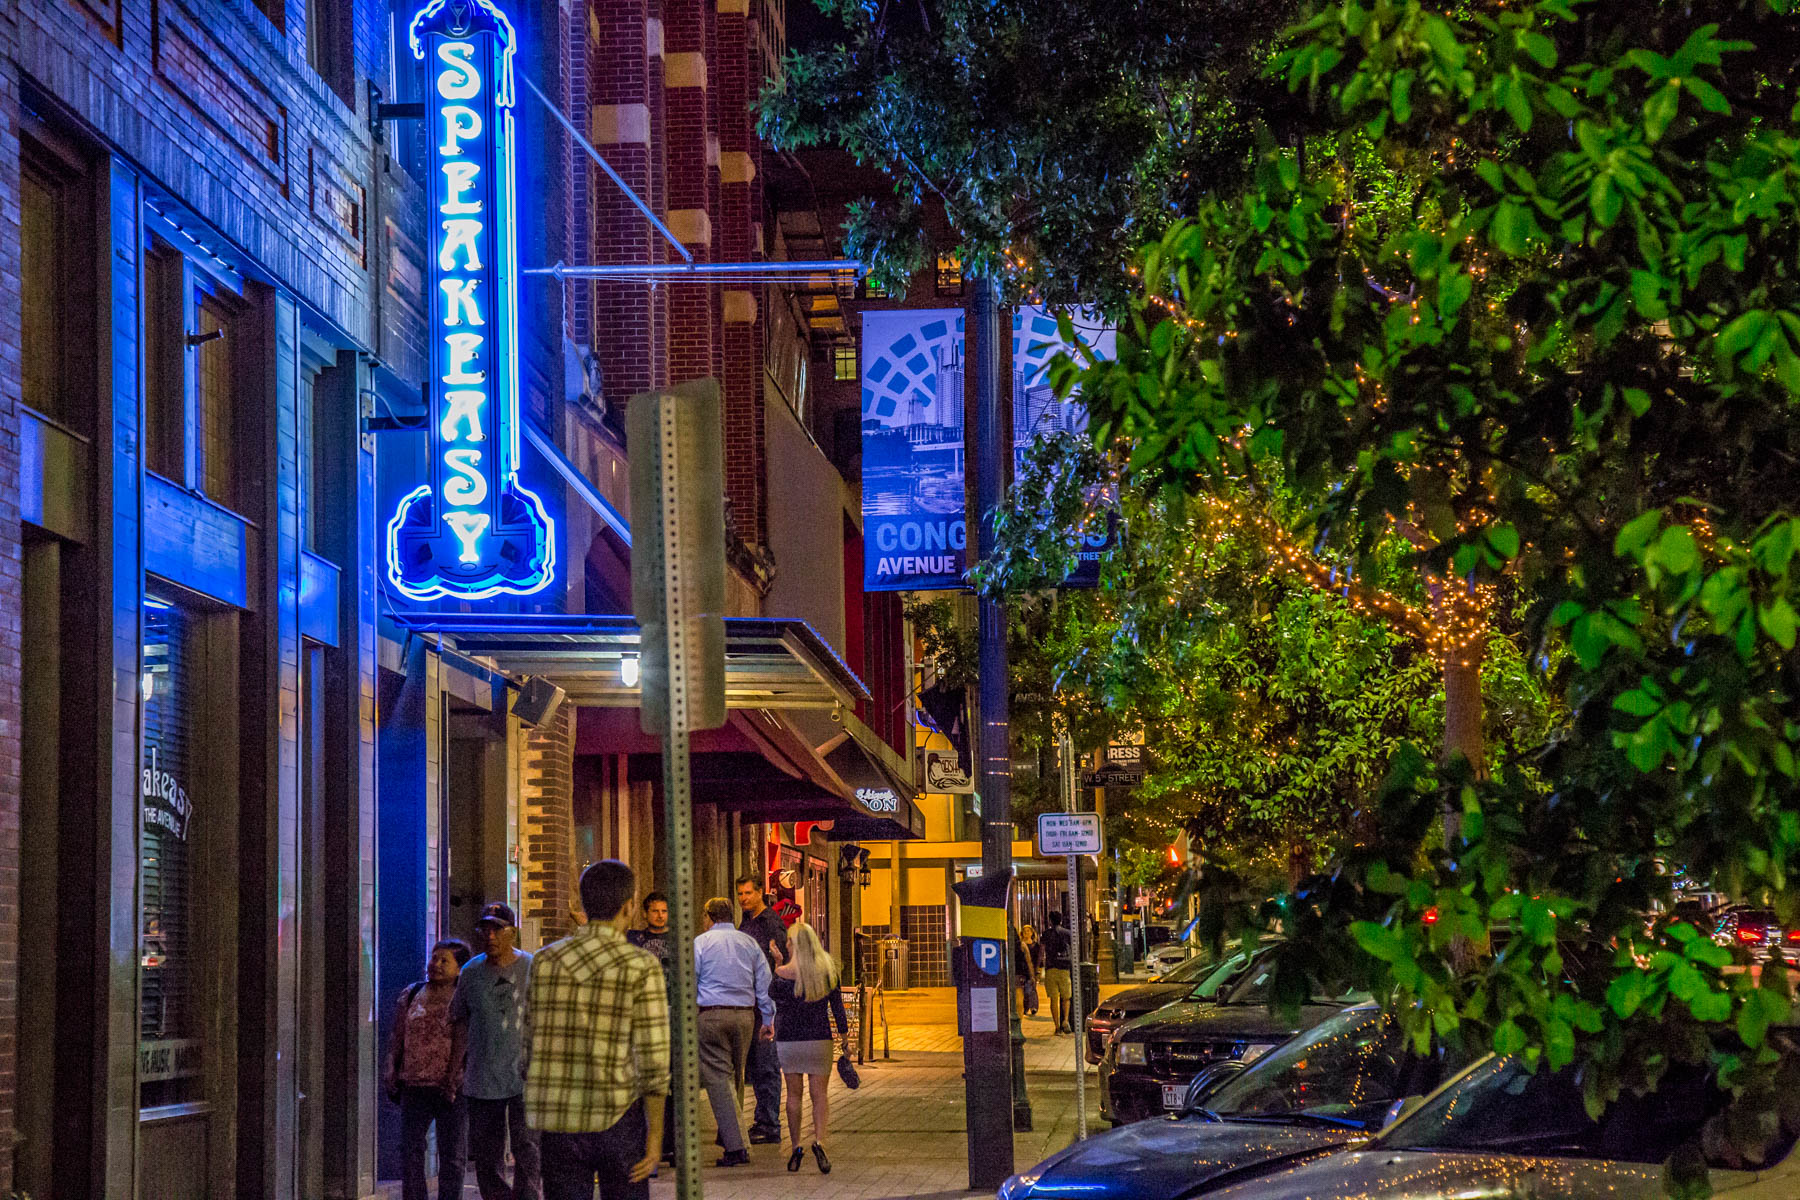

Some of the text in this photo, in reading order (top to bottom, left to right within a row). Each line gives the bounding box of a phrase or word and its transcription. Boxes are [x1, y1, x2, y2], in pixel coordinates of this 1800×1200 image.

[437, 42, 490, 562] SPEAKEASY
[876, 556, 956, 575] AVENUE
[1107, 747, 1140, 759] RESS
[1108, 774, 1140, 782] STREET
[144, 808, 157, 823] THE
[980, 943, 997, 968] P
